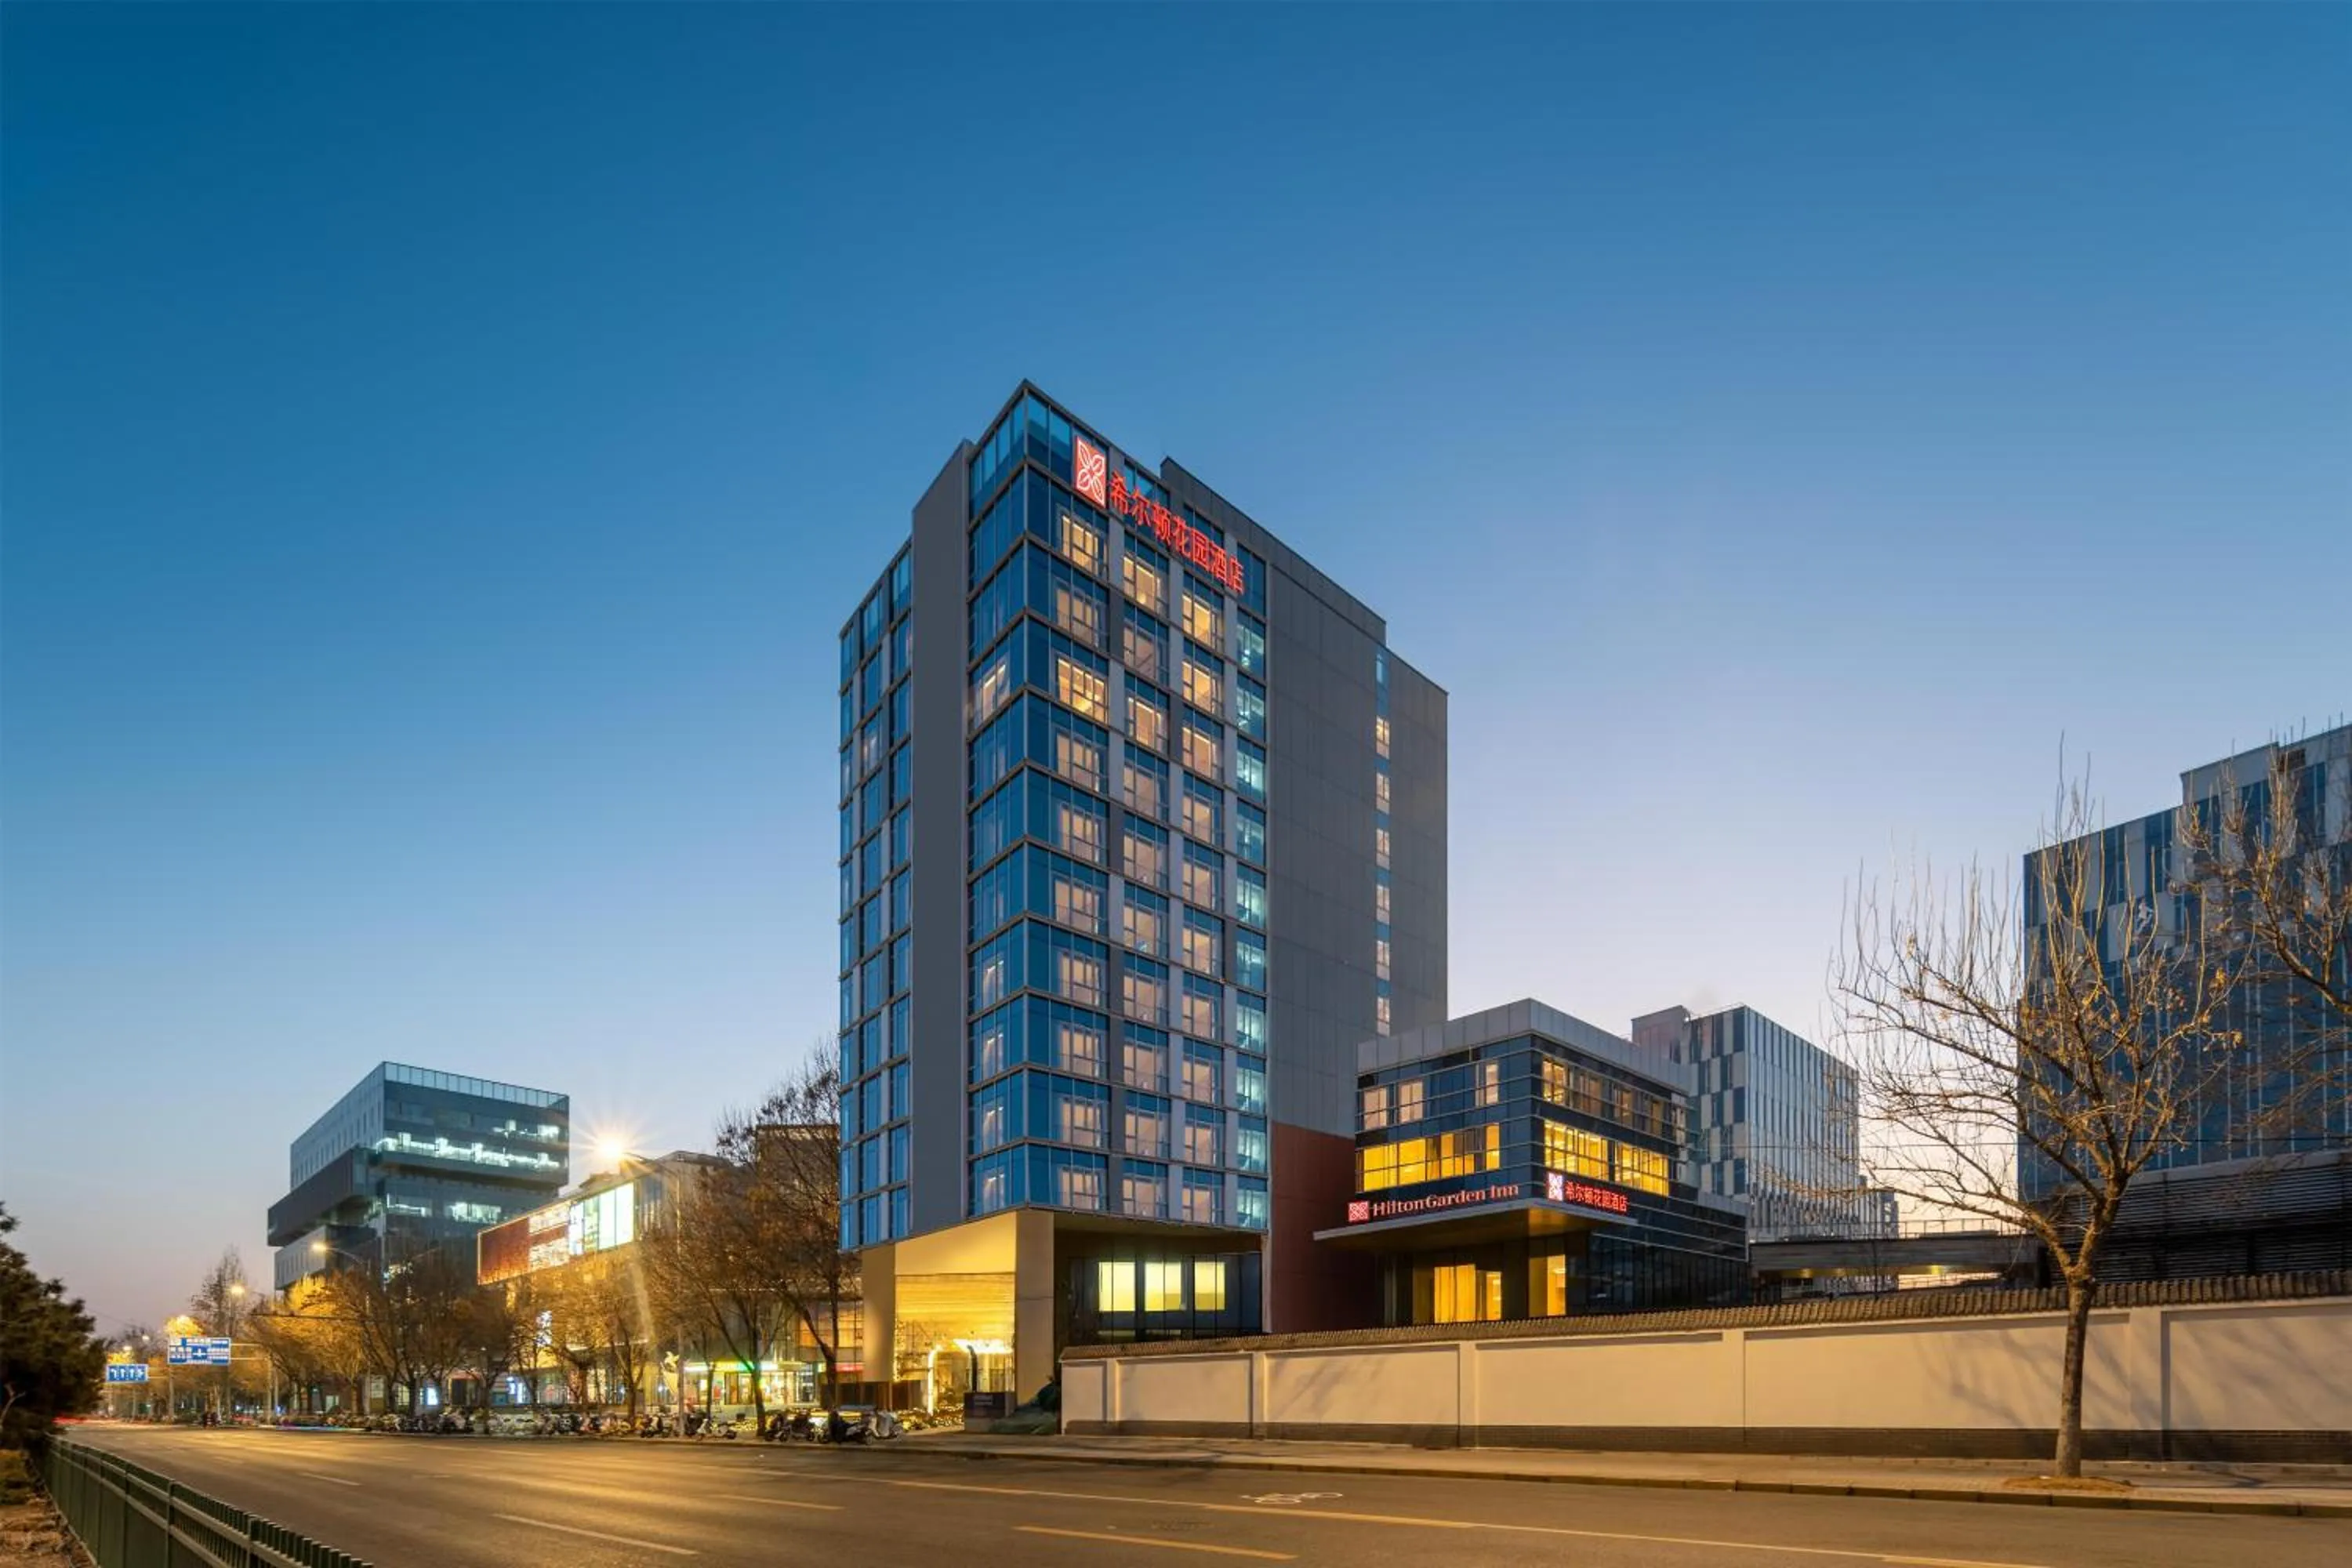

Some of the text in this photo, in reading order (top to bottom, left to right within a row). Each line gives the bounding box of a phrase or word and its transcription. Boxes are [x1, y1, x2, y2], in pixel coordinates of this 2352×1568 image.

[1110, 470, 1244, 593] 希尔顿花园酒店
[1490, 1185, 1519, 1199] Inn
[1565, 1180, 1628, 1213] 希尔顿花园酒店
